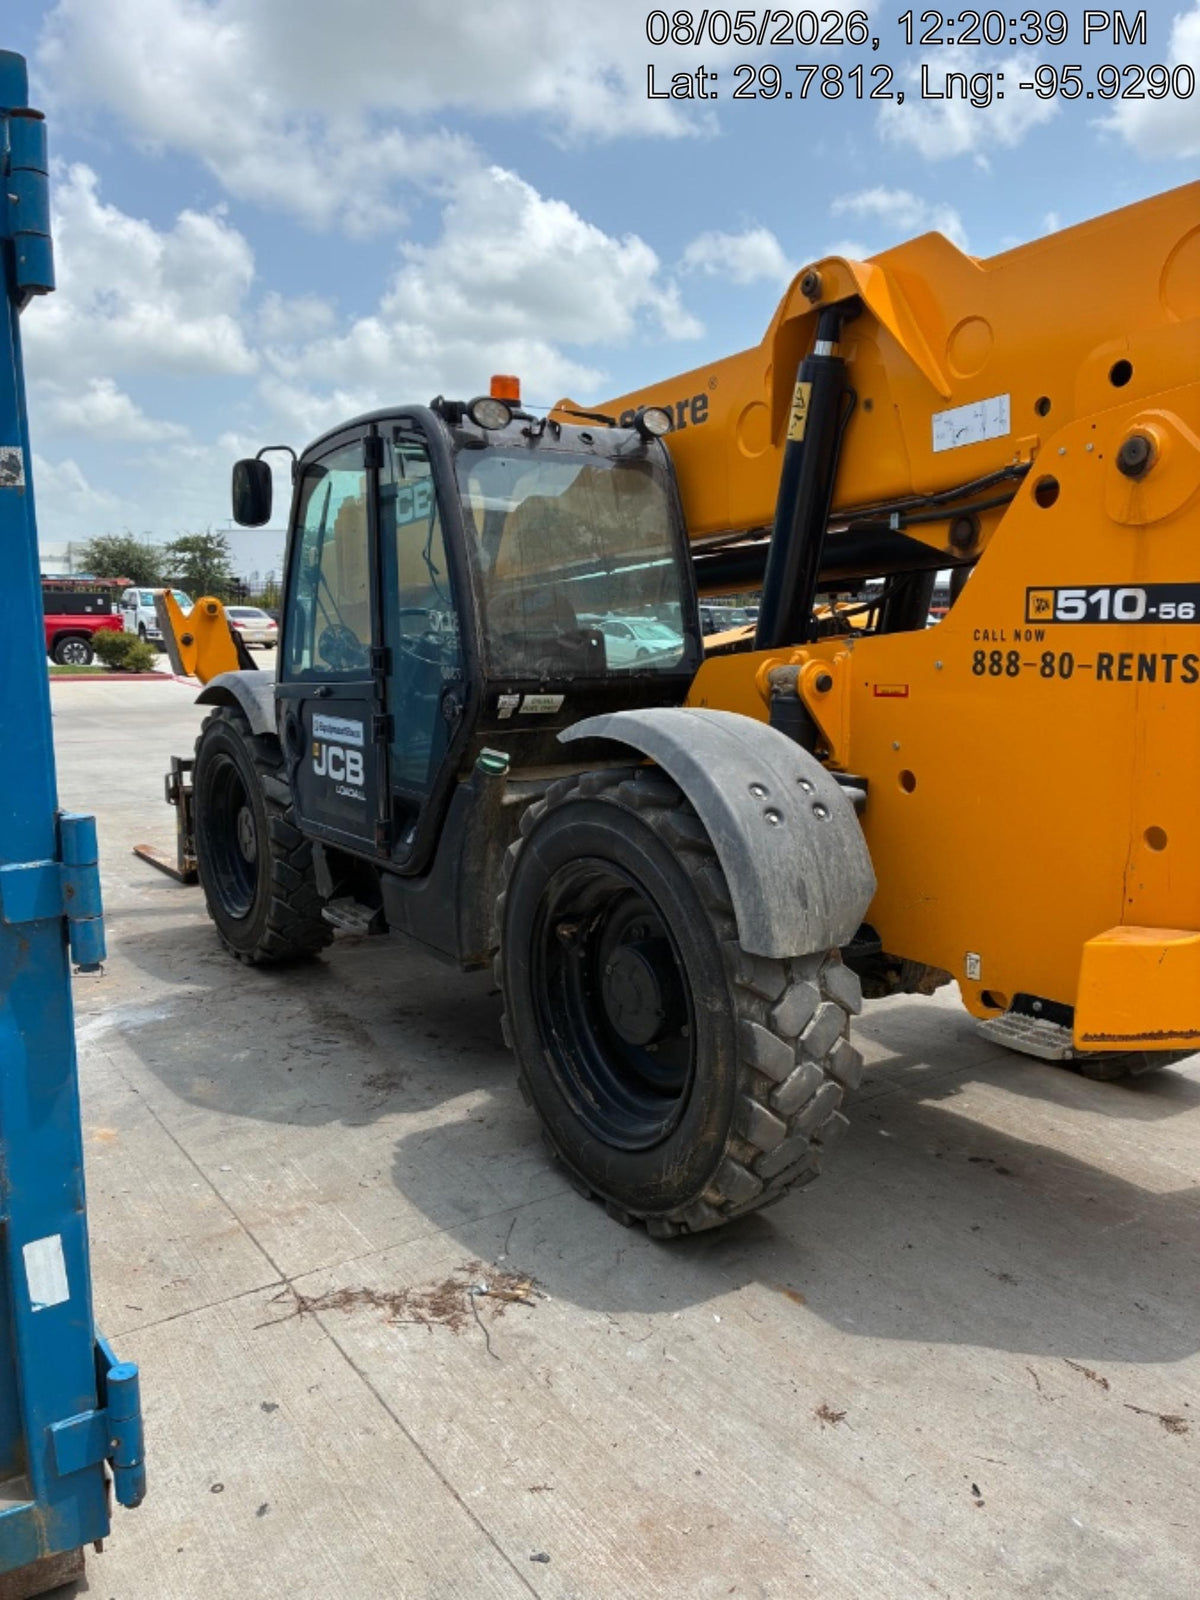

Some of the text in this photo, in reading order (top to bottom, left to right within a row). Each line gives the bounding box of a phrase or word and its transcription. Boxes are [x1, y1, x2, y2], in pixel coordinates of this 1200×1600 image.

[973, 628, 1046, 642] CALL NOW
[971, 650, 1200, 683] 888-80-RENTS
[312, 742, 365, 787] JCB
